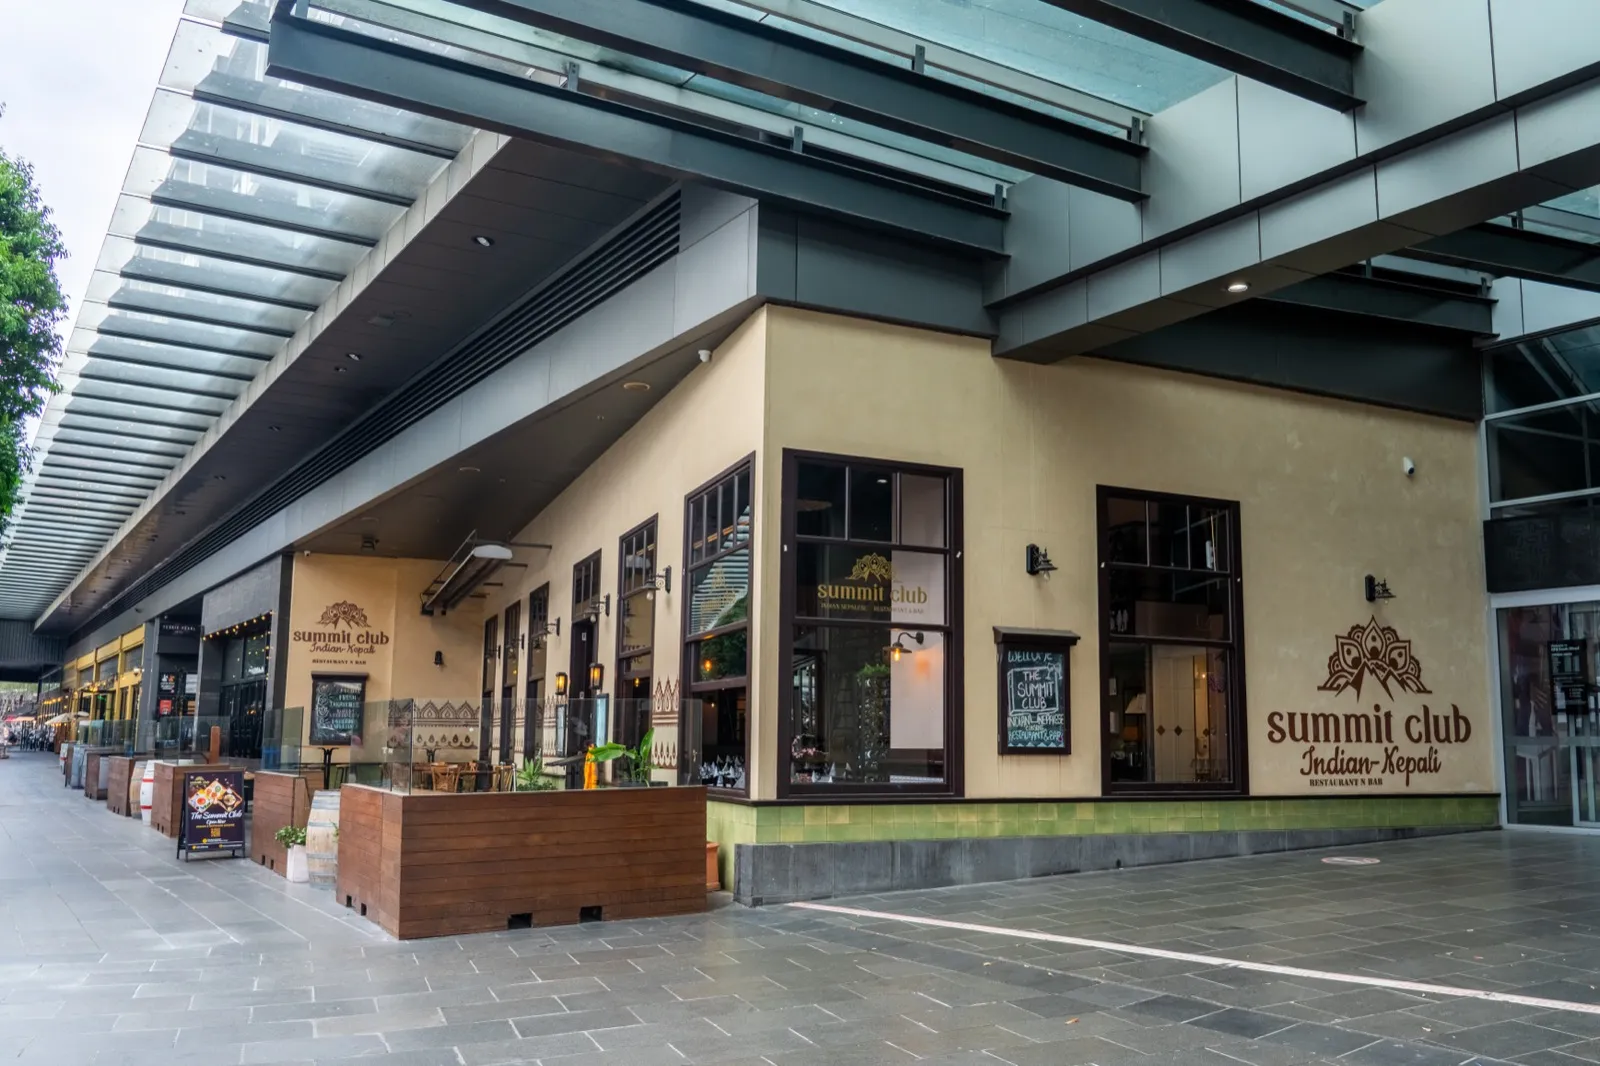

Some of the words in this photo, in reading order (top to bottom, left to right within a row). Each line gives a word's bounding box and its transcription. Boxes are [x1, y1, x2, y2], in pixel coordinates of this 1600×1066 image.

[817, 583, 884, 601] summit
[890, 585, 928, 604] club
[293, 630, 351, 644] summit
[356, 630, 390, 645] club
[1023, 671, 1041, 680] THE
[1017, 681, 1054, 697] SUMMIT
[1021, 697, 1047, 709] CLUB
[1267, 703, 1395, 744] summit
[1404, 703, 1472, 744] club
[1309, 778, 1359, 787] RESTAURANT
[1360, 778, 1366, 786] N
[1368, 777, 1383, 786] BAR
[191, 811, 203, 820] The
